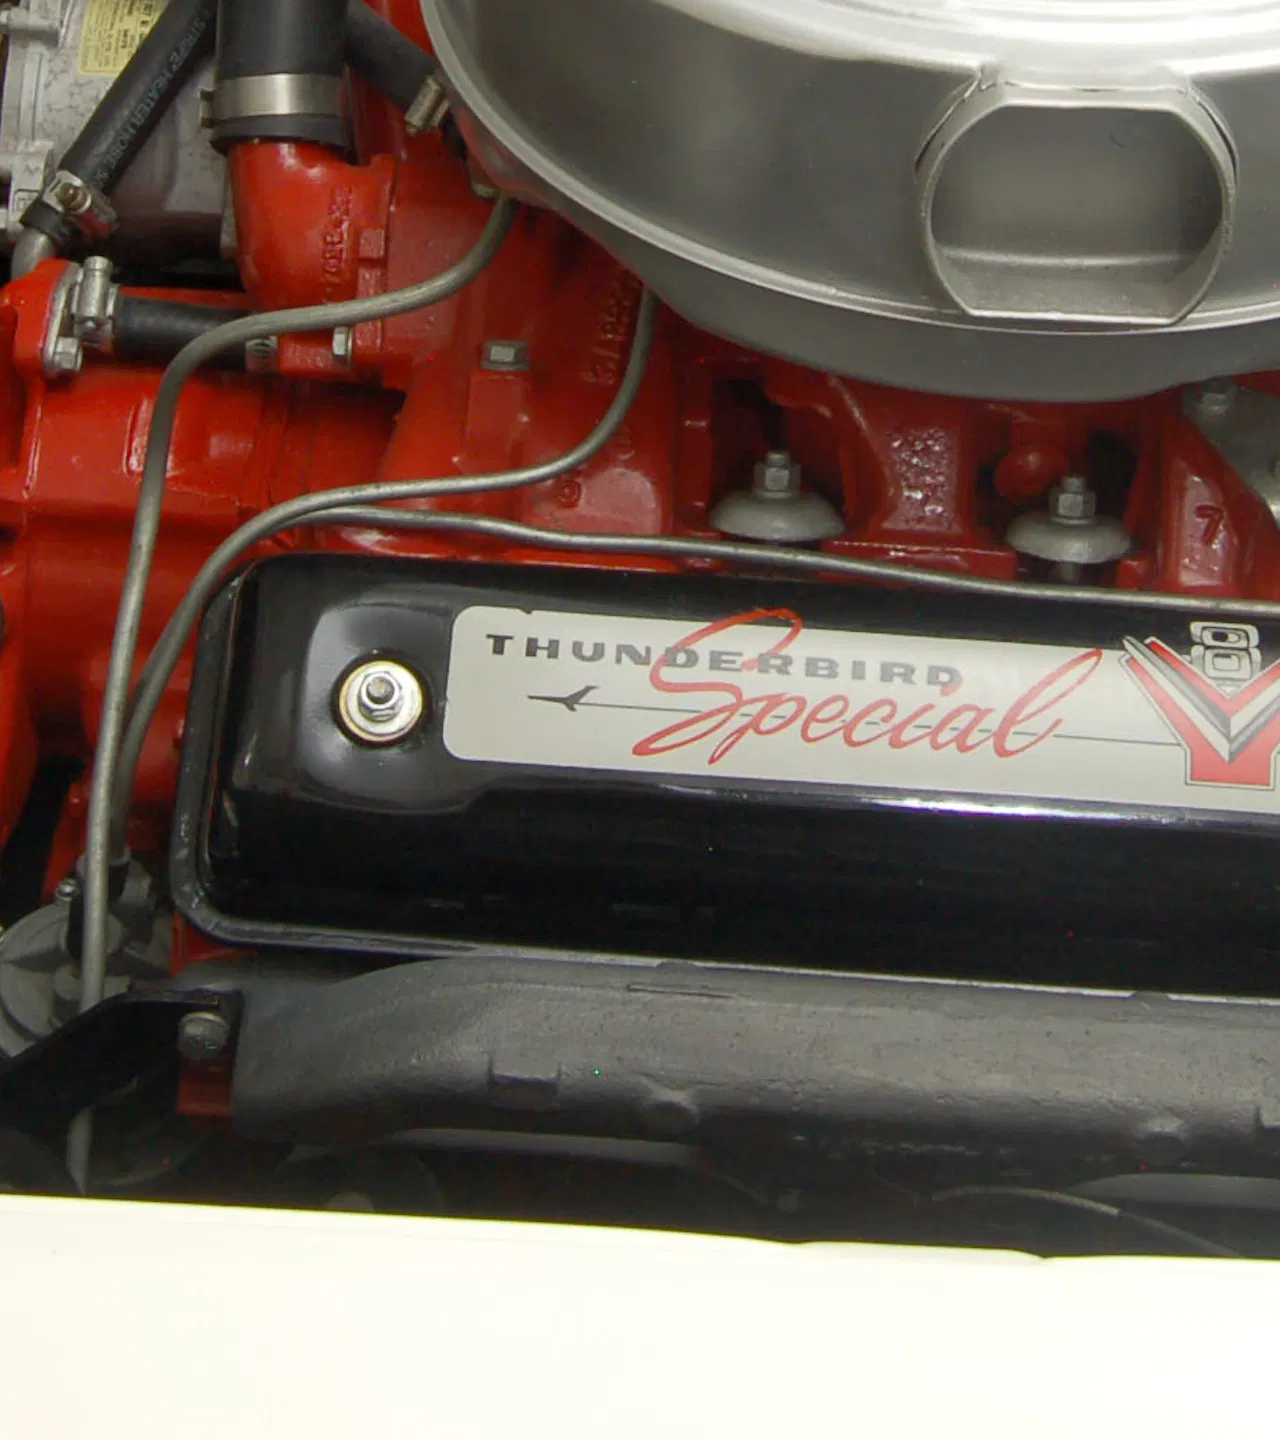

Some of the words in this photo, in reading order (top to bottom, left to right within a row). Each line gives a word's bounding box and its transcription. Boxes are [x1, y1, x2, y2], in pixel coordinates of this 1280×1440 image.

[100, 122, 138, 169] HOSE
[486, 633, 962, 686] THUNDERBIRD
[631, 608, 1104, 765] Special
